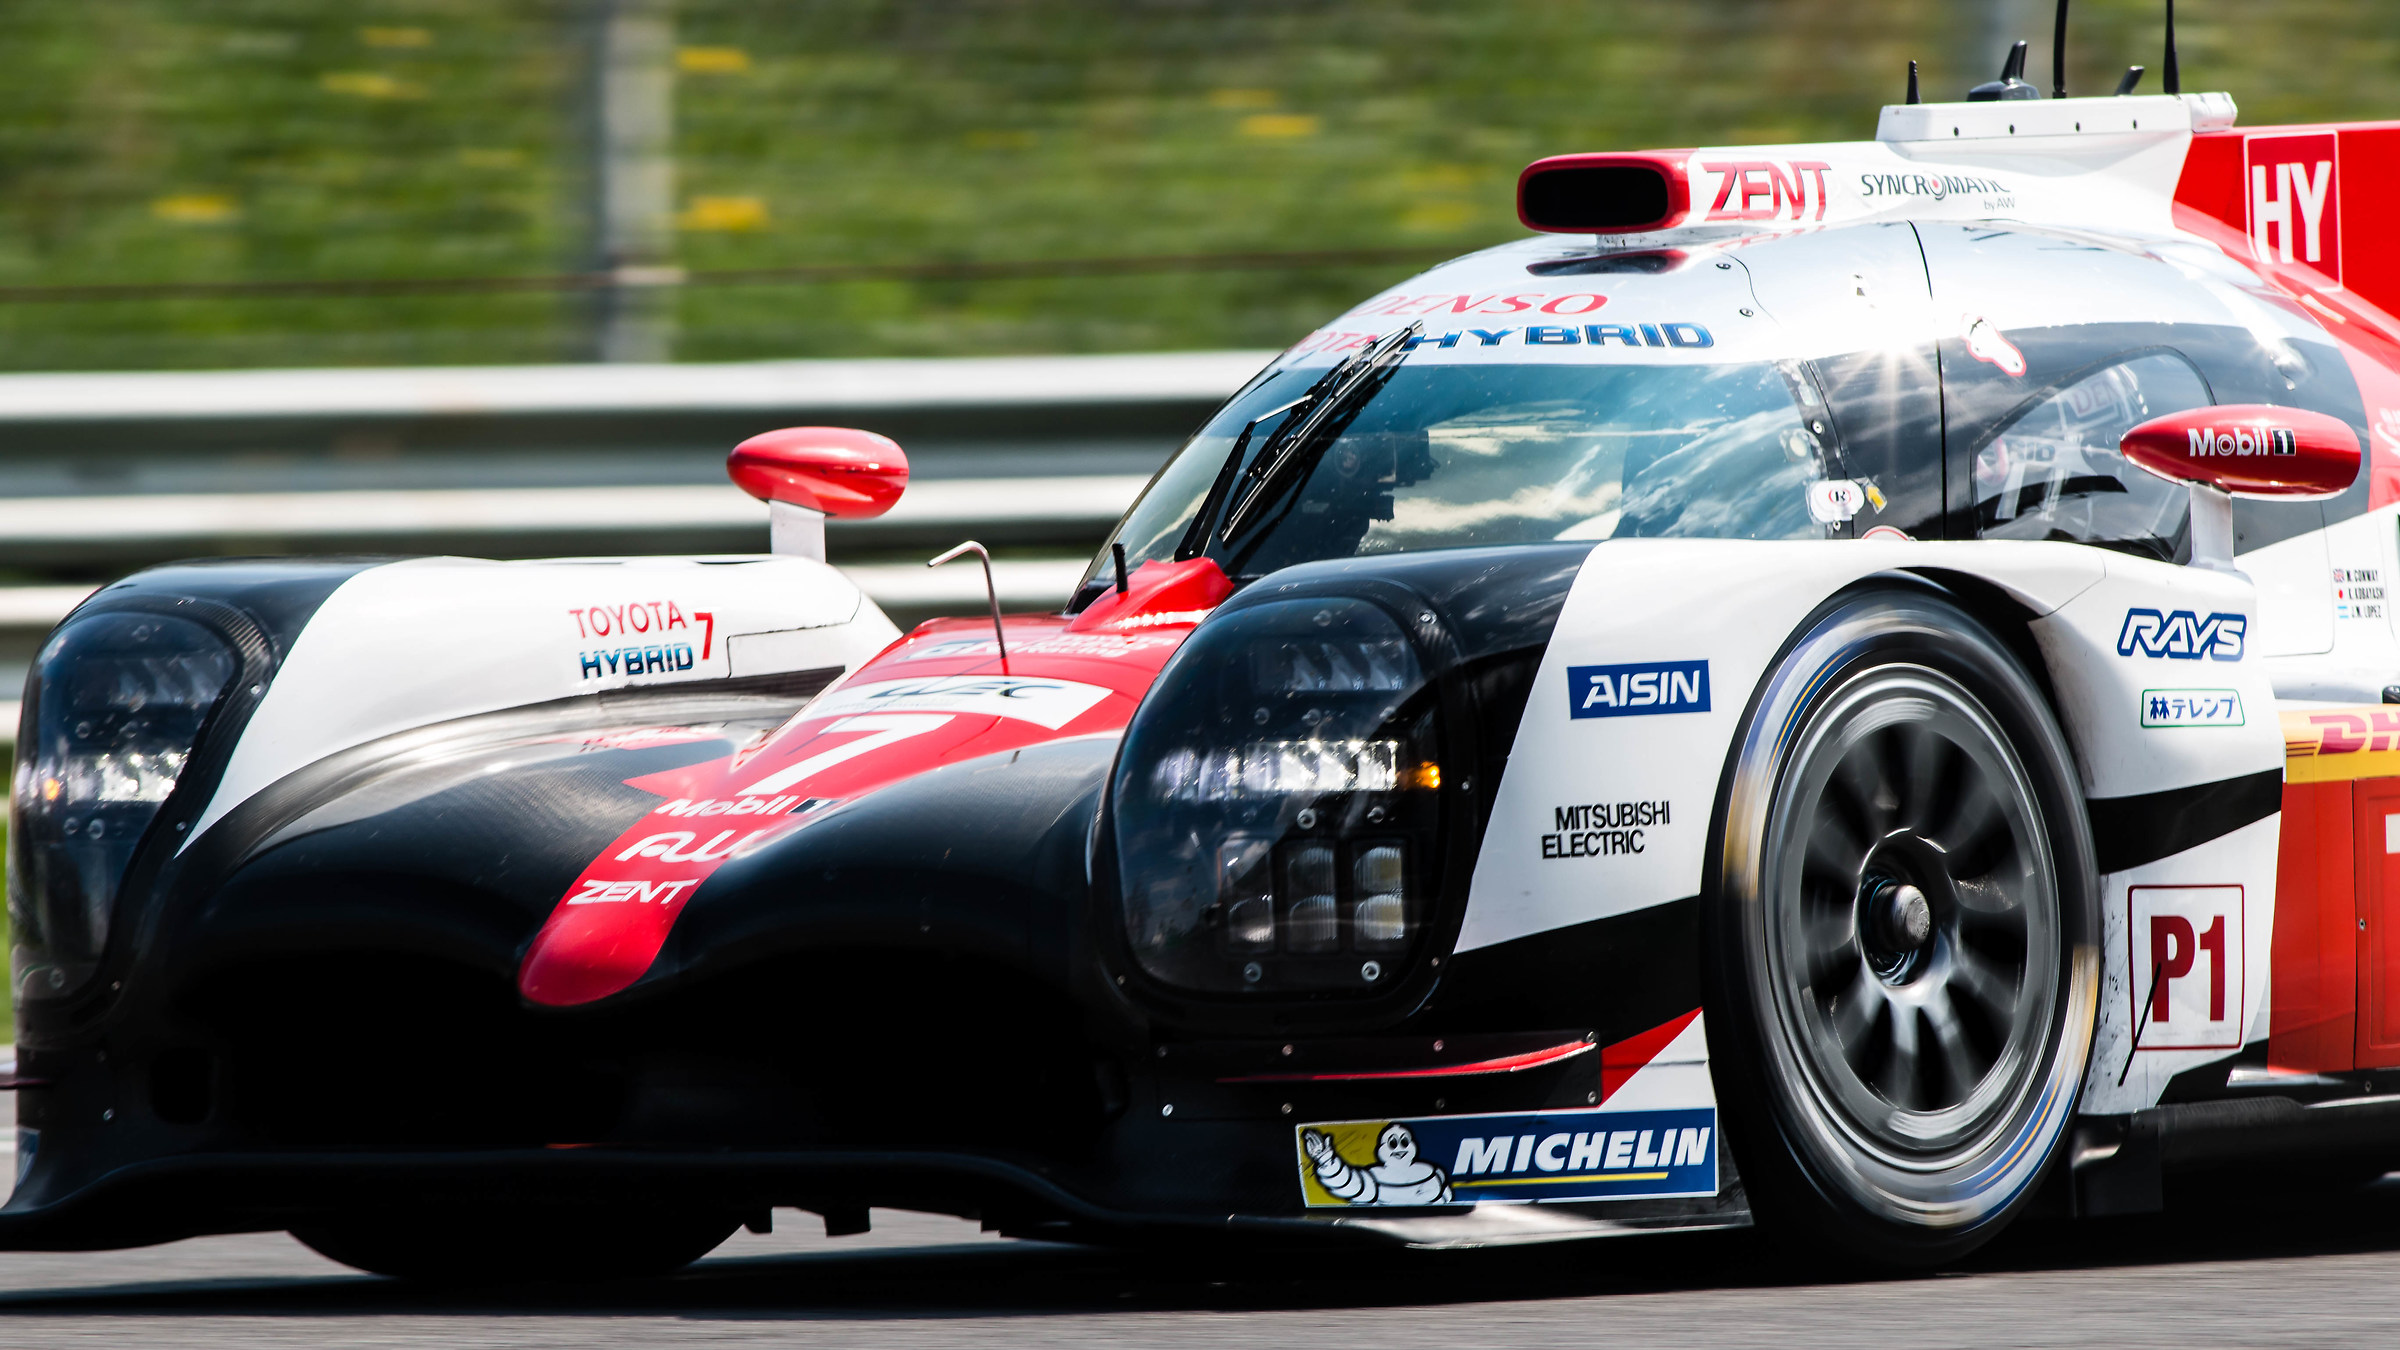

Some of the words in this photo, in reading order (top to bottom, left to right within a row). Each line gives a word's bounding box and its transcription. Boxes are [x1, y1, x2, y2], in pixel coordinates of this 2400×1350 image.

[1703, 161, 1832, 222] ZENT
[1984, 200, 1995, 211] by
[1997, 198, 2016, 209] AW
[2252, 161, 2332, 264] HY
[1348, 293, 1608, 315] DENSO
[1399, 321, 1714, 352] HYBRID
[2187, 427, 2269, 457] Mobil
[568, 600, 687, 639] TOYOTA
[694, 612, 713, 660] 7
[2118, 608, 2247, 661] RAYS
[579, 642, 693, 679] HYBRID
[1582, 669, 1700, 709] AISIN
[735, 713, 956, 796] 7
[2309, 714, 2400, 756] DH
[653, 796, 801, 817] Mobil
[1555, 800, 1670, 831] MITSUBISHI
[1541, 829, 1645, 859] ELECTRIC
[566, 879, 699, 905] ZENT
[2150, 915, 2225, 1022] P1
[1451, 1126, 1711, 1176] MICHELIN
